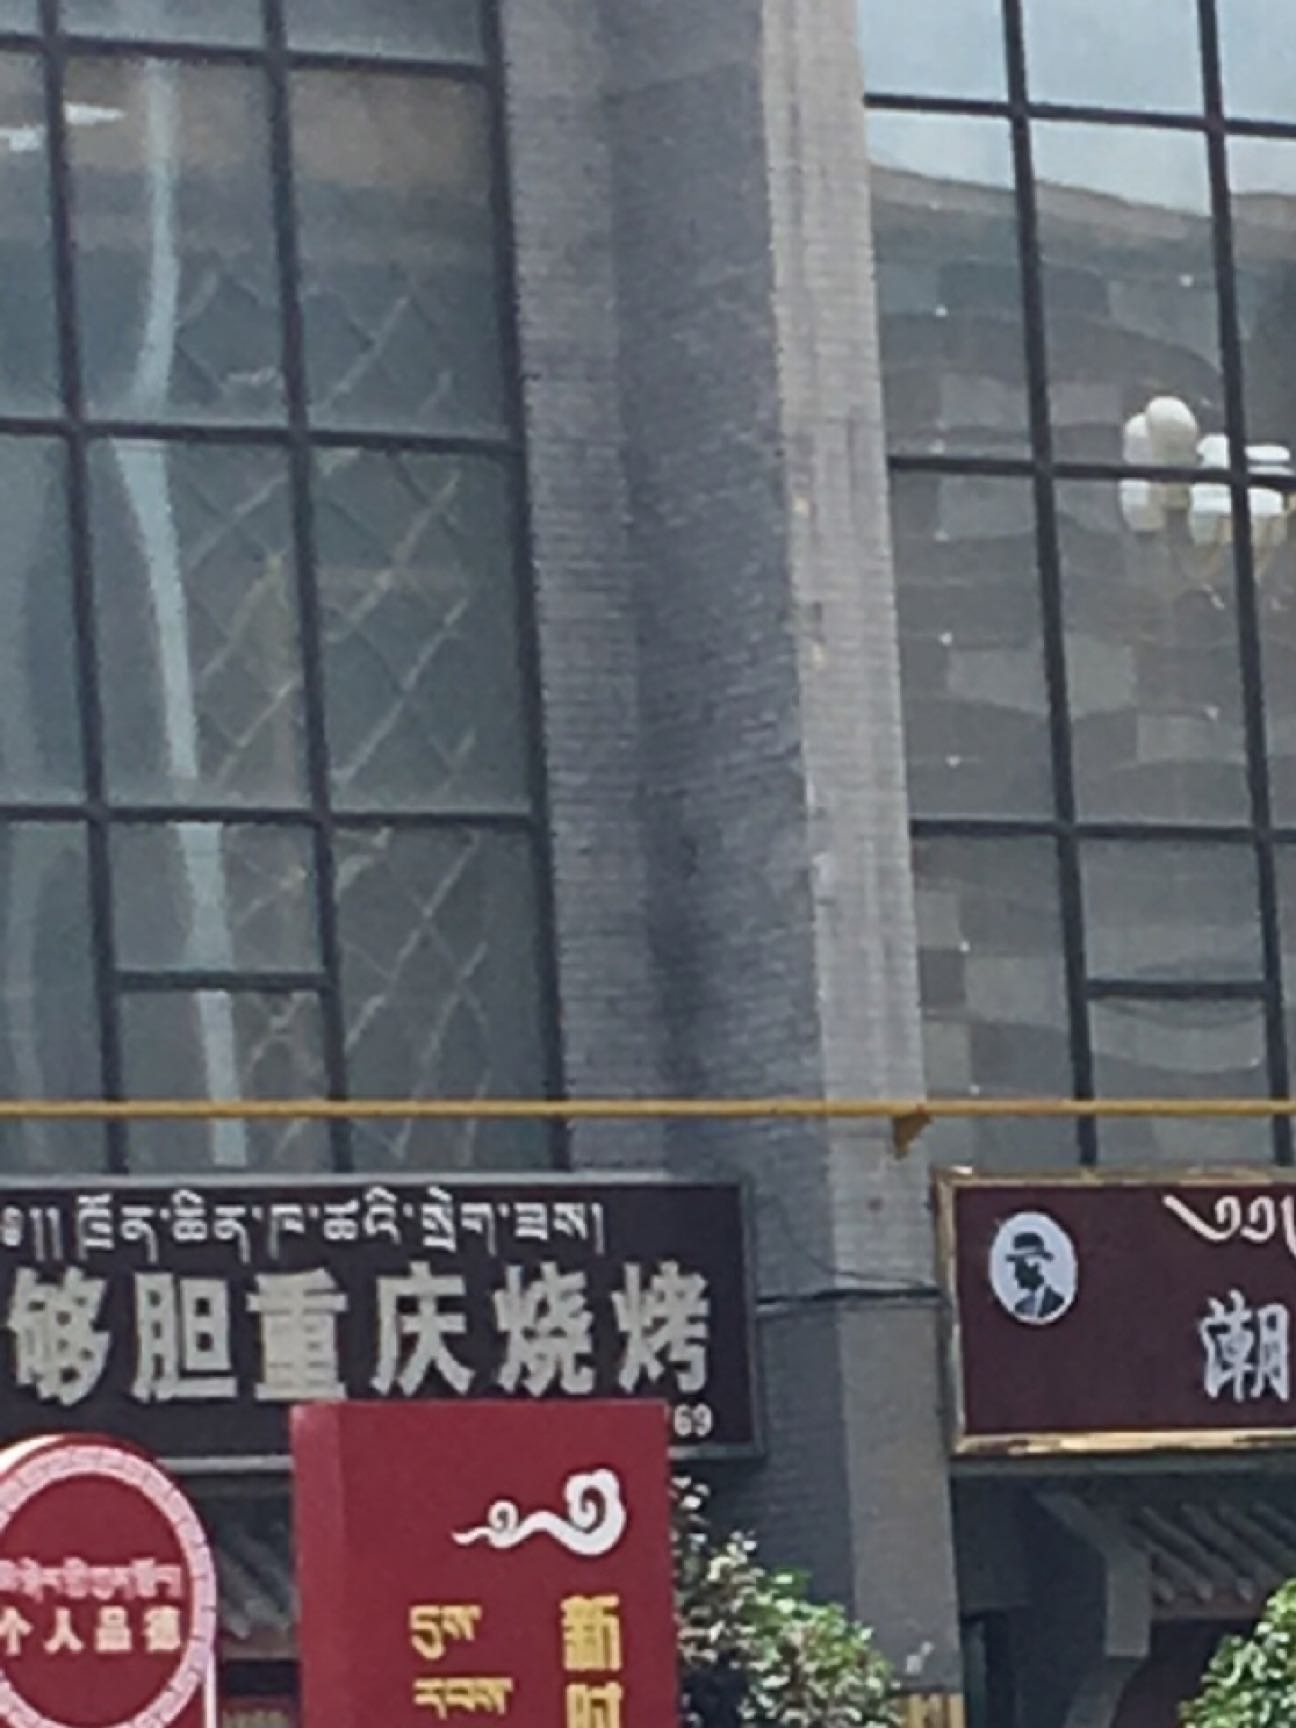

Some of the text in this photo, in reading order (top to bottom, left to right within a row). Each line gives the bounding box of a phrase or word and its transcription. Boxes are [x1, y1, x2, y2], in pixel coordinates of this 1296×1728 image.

[8, 1261, 709, 1404] 够胆重庆烧烤
